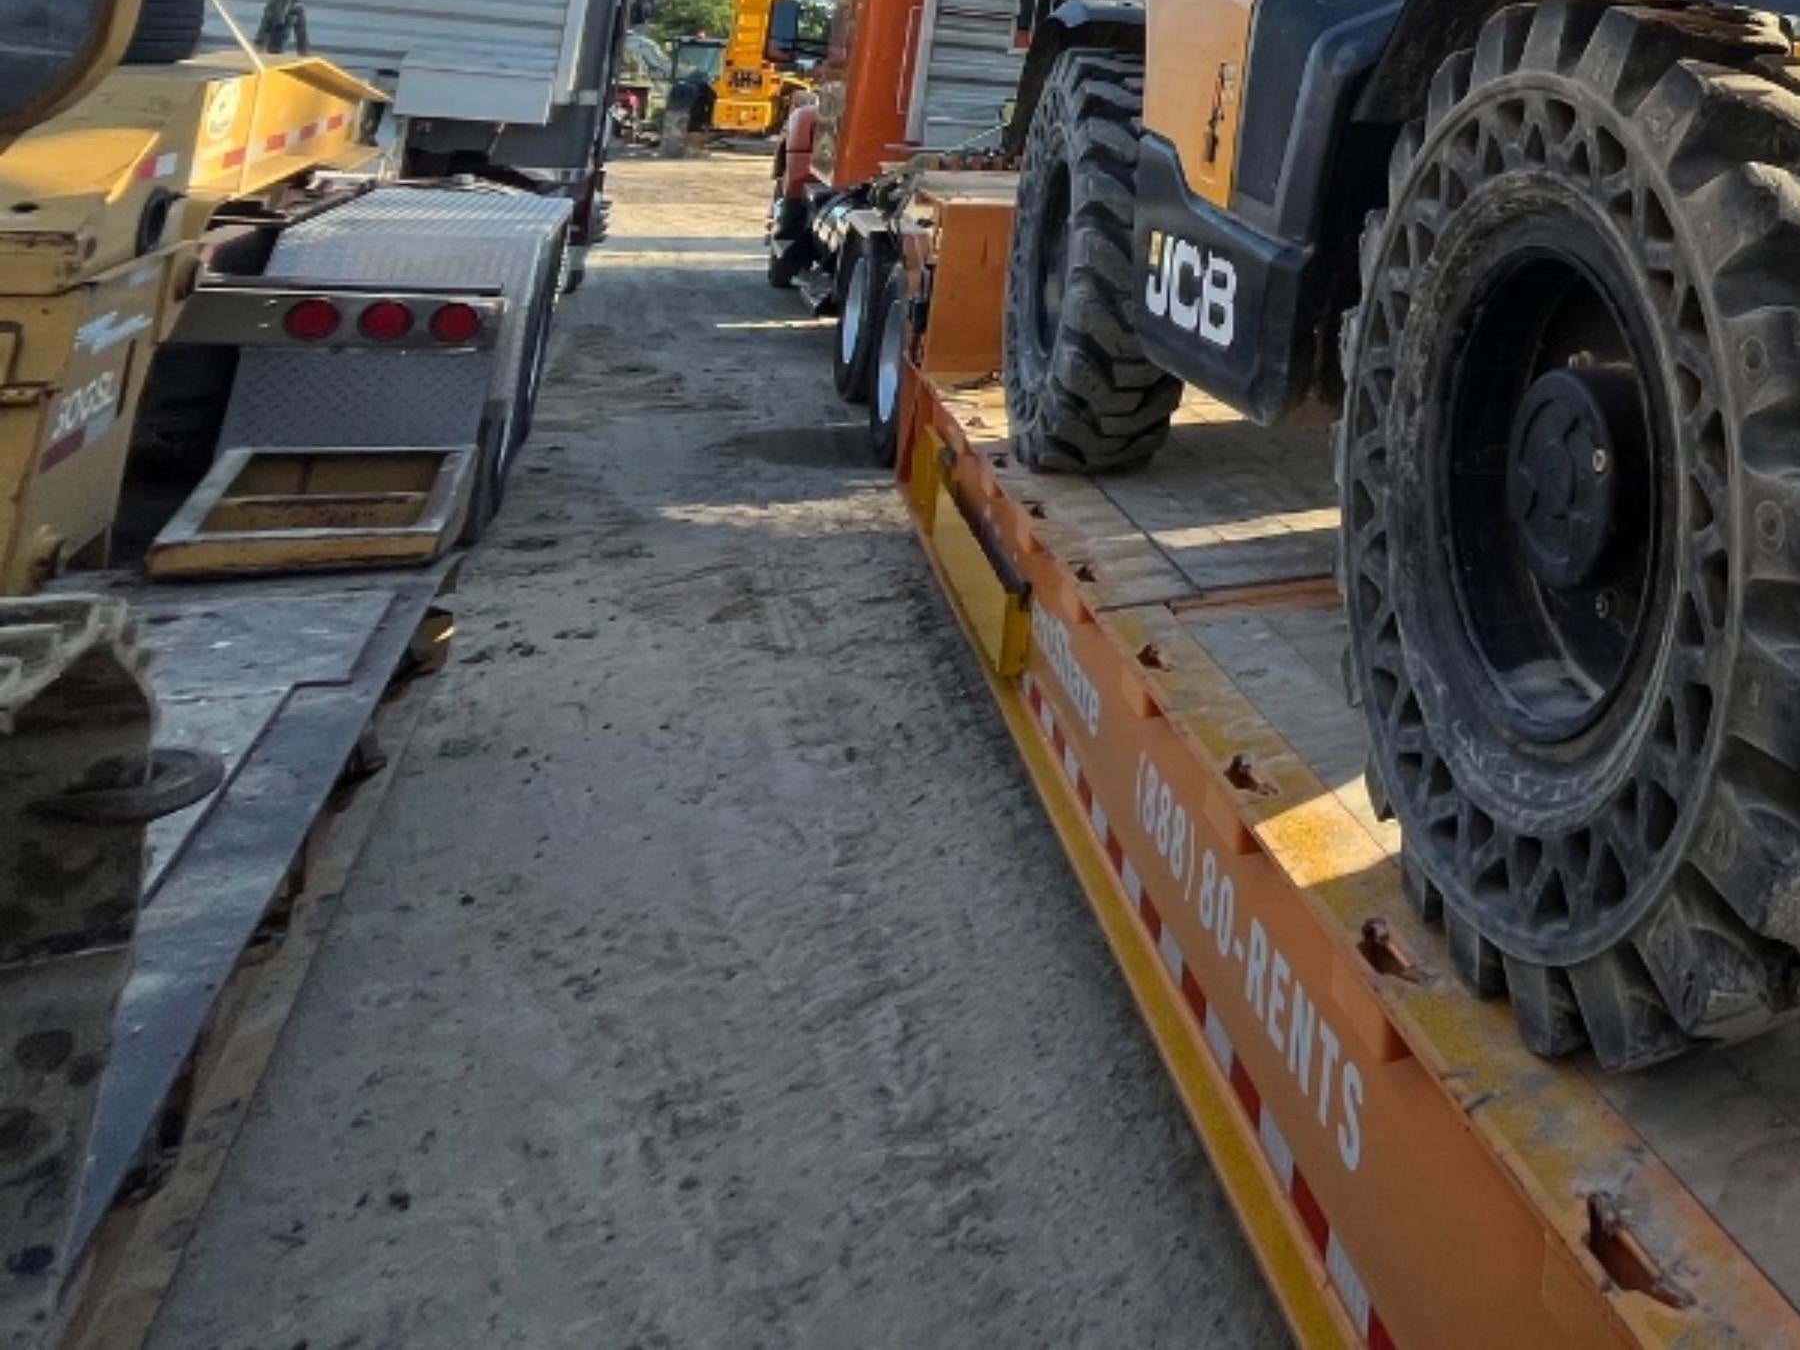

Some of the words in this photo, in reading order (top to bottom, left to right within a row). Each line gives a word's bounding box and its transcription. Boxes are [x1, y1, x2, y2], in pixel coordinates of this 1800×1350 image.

[1145, 234, 1237, 347] JCB
[1135, 749, 1195, 902] (888)
[1199, 848, 1364, 1172] 80-RENTS
